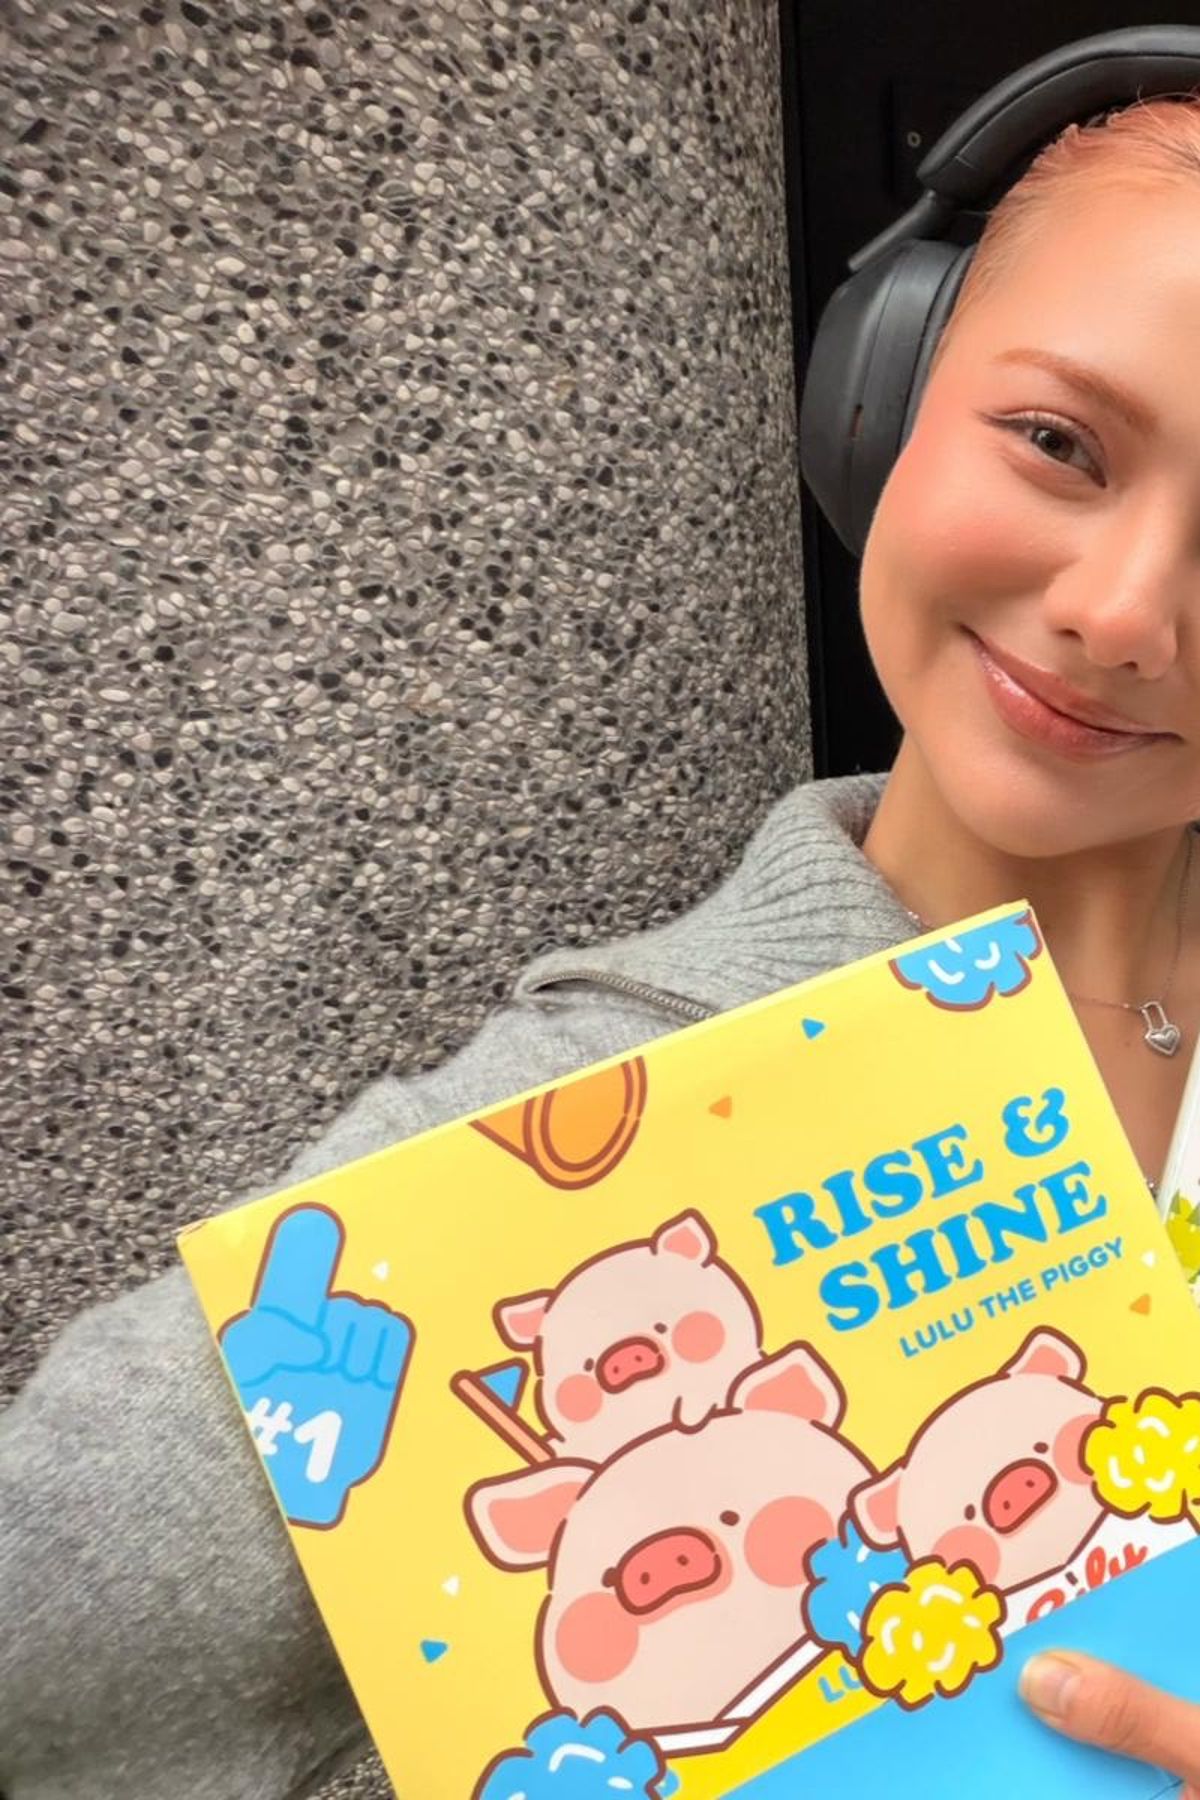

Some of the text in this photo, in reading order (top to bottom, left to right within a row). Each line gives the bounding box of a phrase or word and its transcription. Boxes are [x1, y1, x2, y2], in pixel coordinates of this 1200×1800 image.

[753, 1087, 1069, 1266] RISE &
[819, 1160, 1107, 1331] SHINE
[899, 1237, 1124, 1358] LULU THE PIGGY
[244, 1397, 342, 1483] #1
